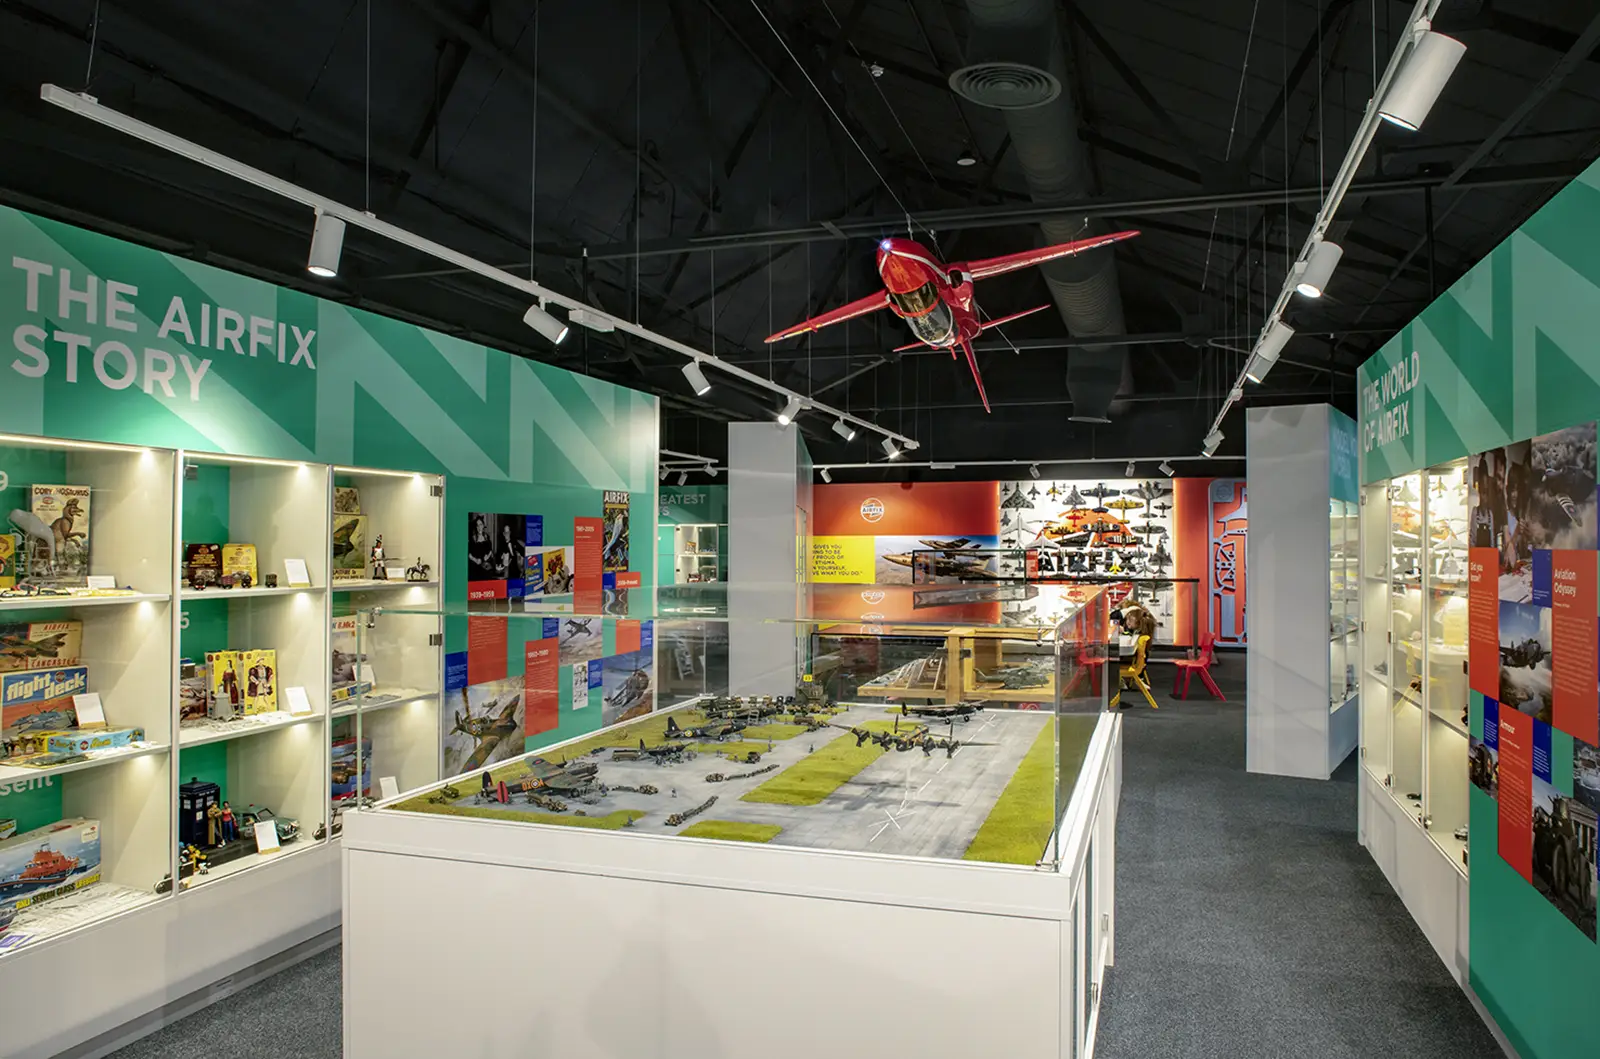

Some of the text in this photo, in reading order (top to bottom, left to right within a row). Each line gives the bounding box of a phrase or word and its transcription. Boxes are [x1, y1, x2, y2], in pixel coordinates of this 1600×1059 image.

[12, 256, 317, 370] THE AIRFIX
[11, 324, 212, 402] STORY
[1363, 351, 1420, 414] THE WORLD
[1364, 401, 1410, 453] OF AIRFIX
[604, 490, 629, 505] AIRFIX
[1554, 568, 1577, 581] Aviation
[1554, 582, 1577, 598] Odyssey
[43, 623, 70, 631] AIRFIX
[31, 656, 77, 668] LANCASTER
[7, 672, 87, 701] flight deck
[56, 882, 76, 896] CLASS
